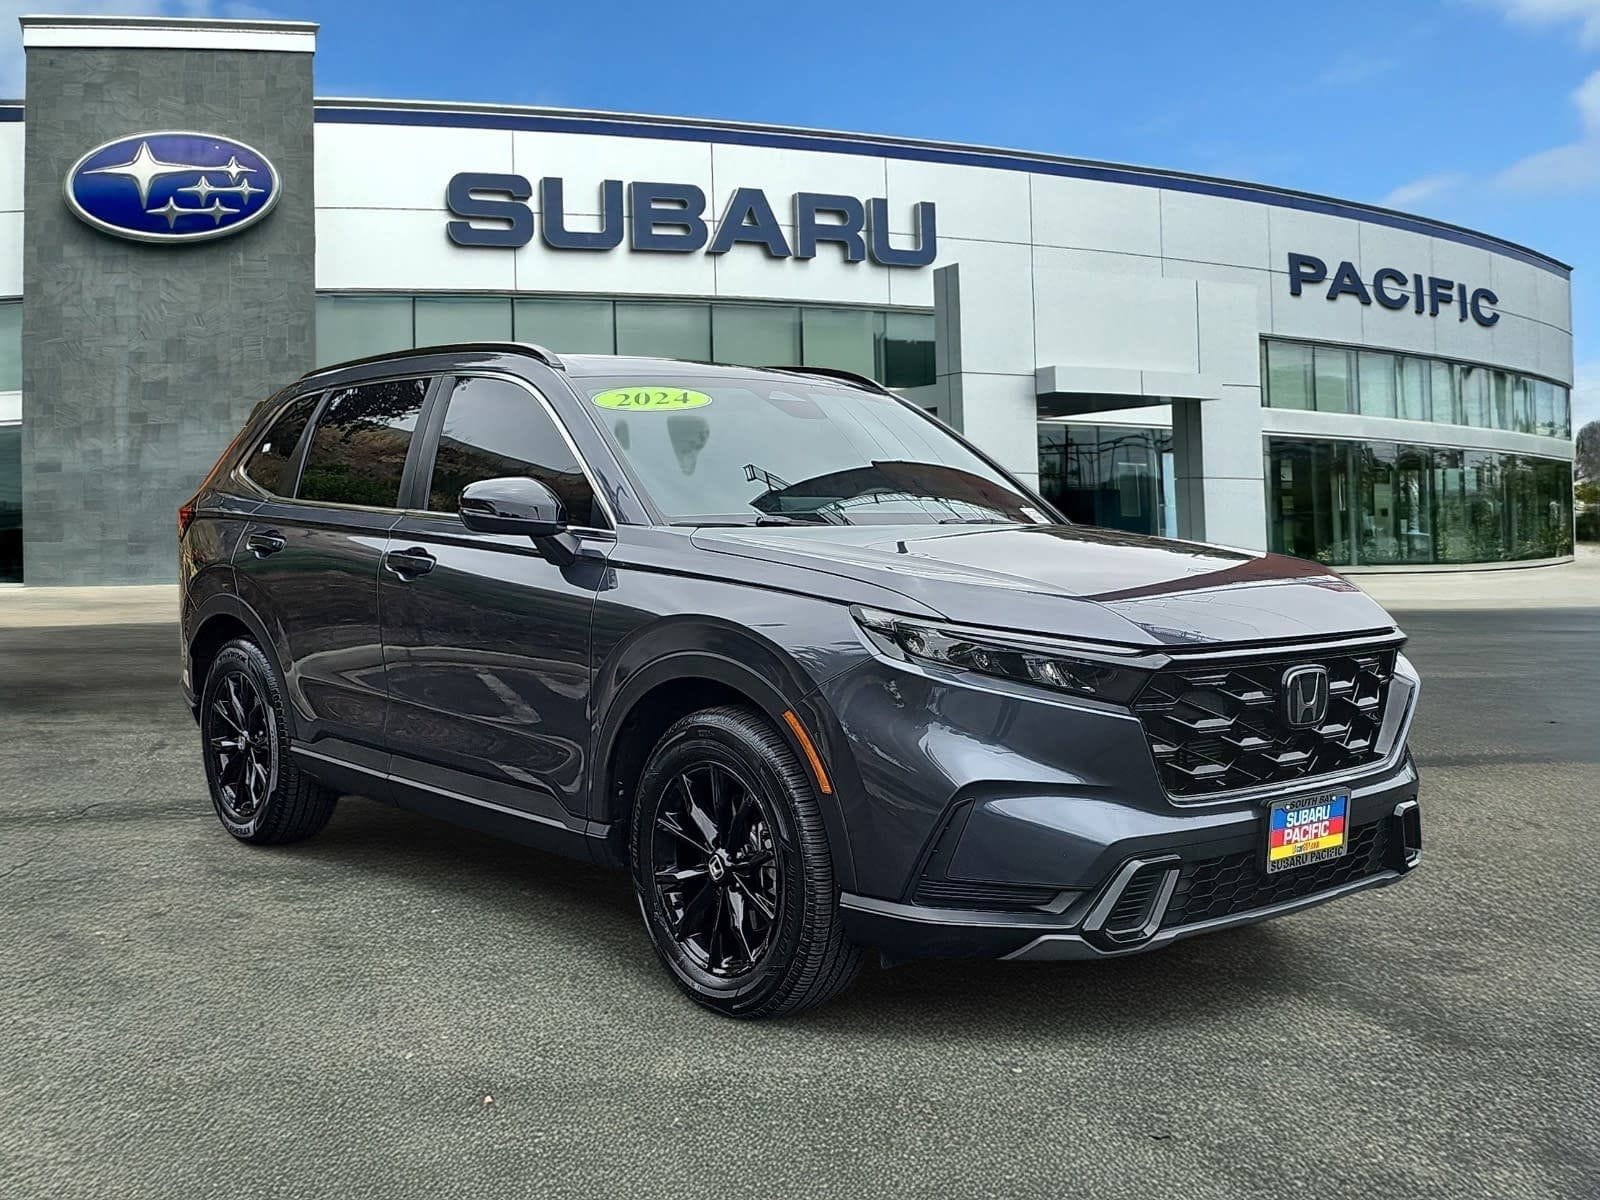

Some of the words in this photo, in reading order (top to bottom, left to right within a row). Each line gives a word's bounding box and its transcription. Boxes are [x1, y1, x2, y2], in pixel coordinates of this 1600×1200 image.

[447, 171, 938, 267] SUBARU
[1287, 252, 1501, 327] PACIFIC
[615, 391, 690, 406] 2024
[1290, 797, 1318, 809] SOUTH
[1287, 805, 1330, 827] SUBARU
[1284, 822, 1330, 845] PACIFIC
[1271, 854, 1308, 871] SUBARU
[1310, 847, 1343, 862] PACIFIC
